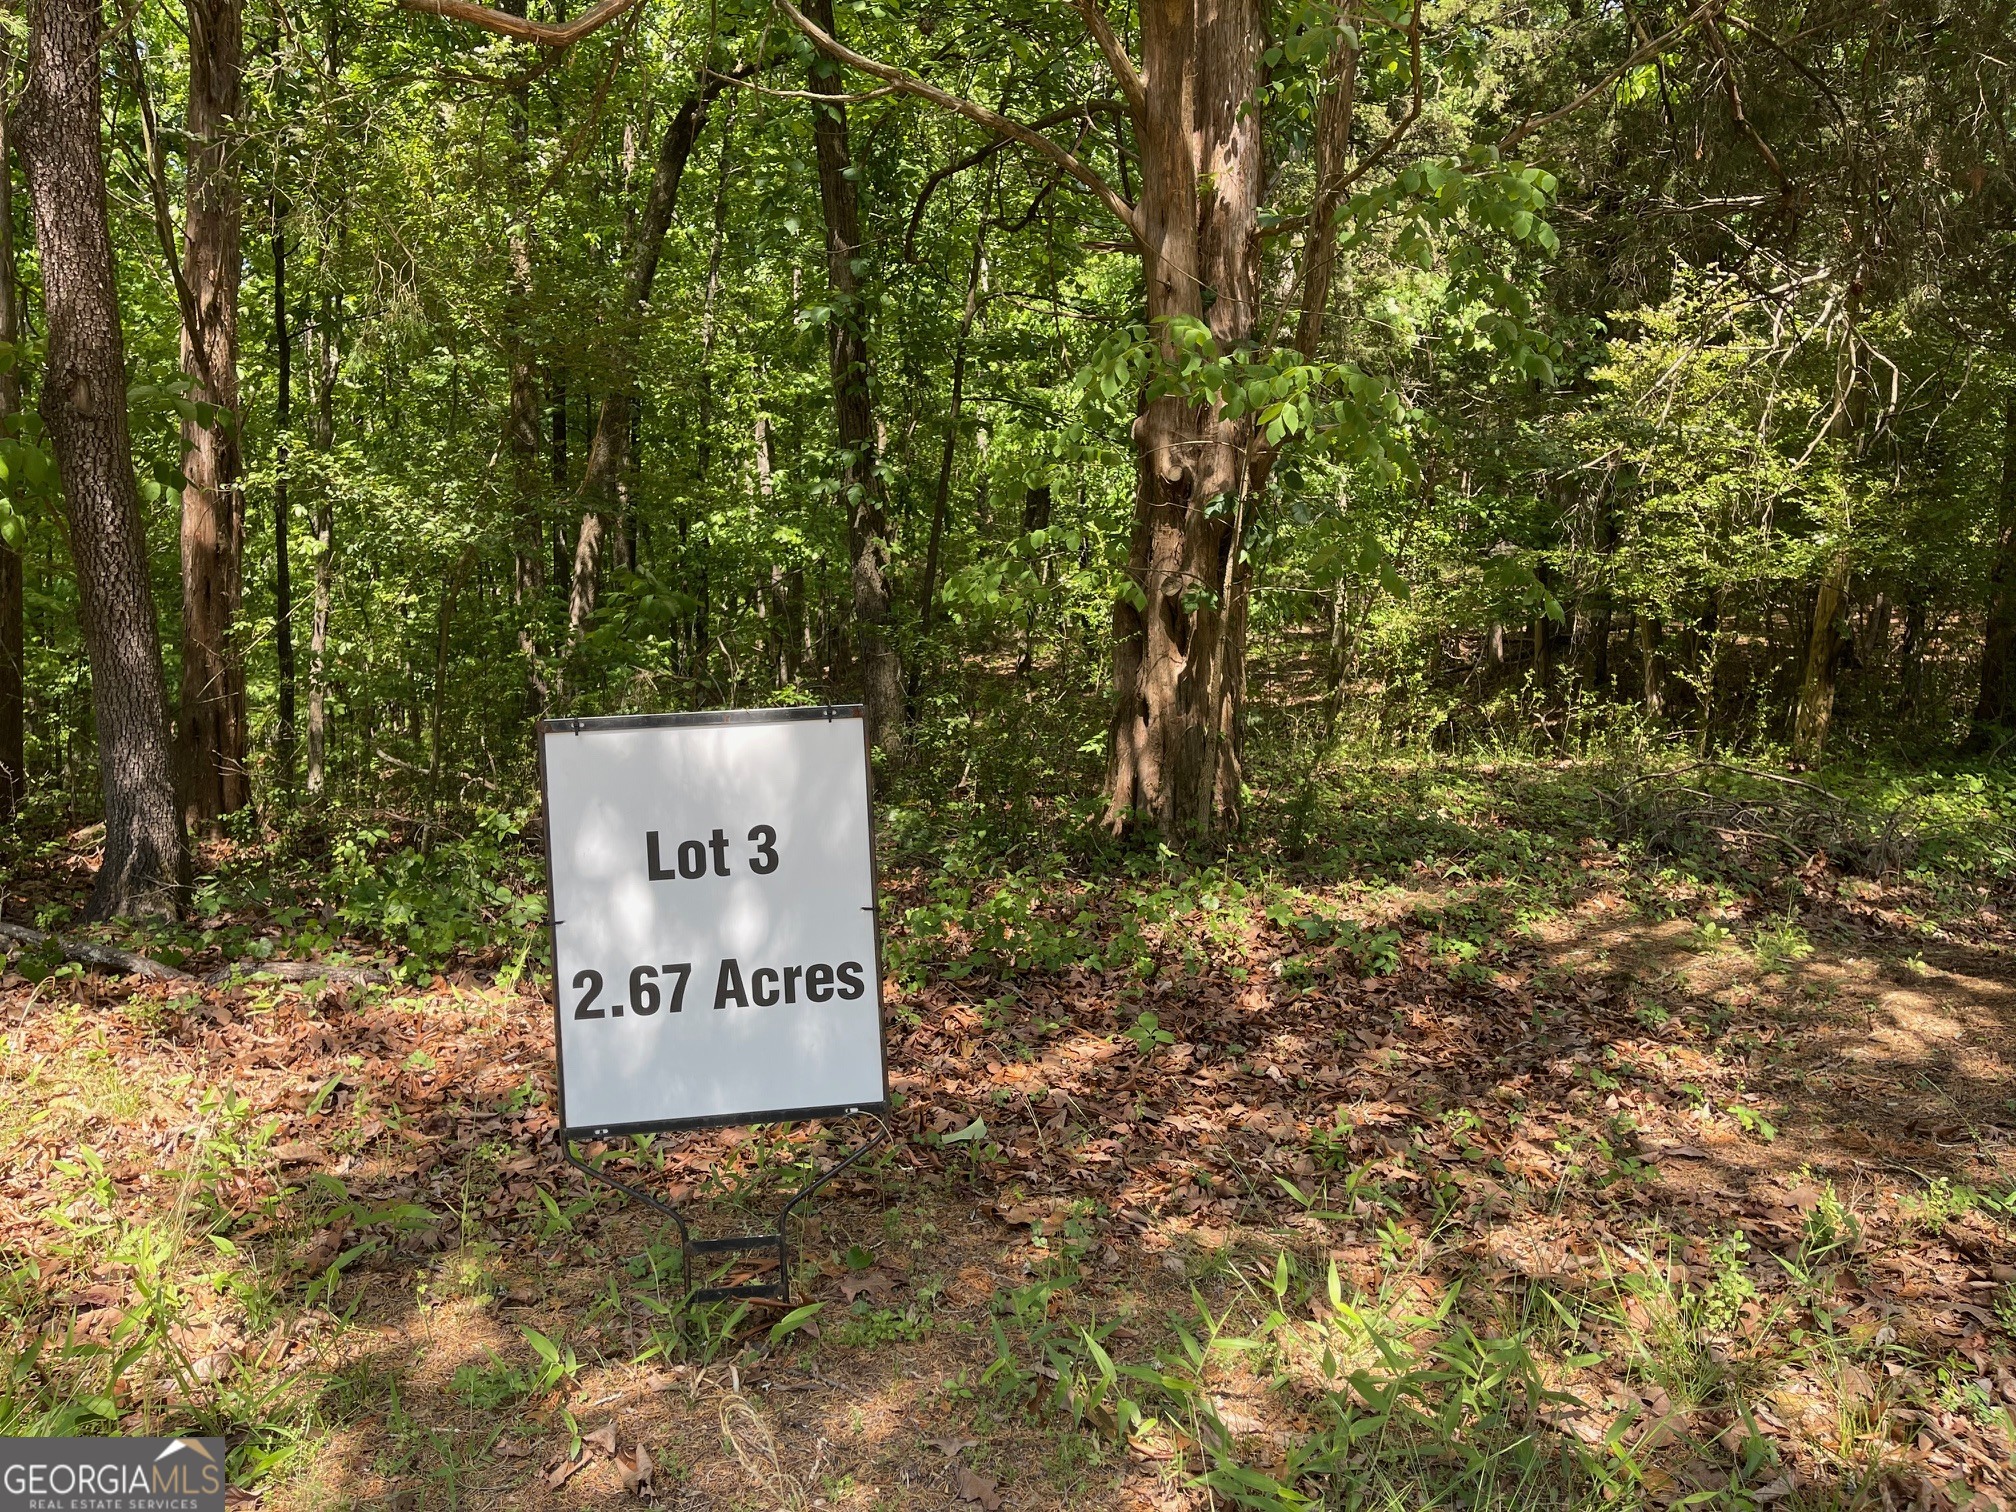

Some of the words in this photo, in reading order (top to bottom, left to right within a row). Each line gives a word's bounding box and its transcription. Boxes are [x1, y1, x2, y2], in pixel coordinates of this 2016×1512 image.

[646, 829, 731, 882] Lot
[747, 824, 779, 875] 3
[572, 963, 692, 1021] 2.67
[713, 958, 865, 1010] Acres
